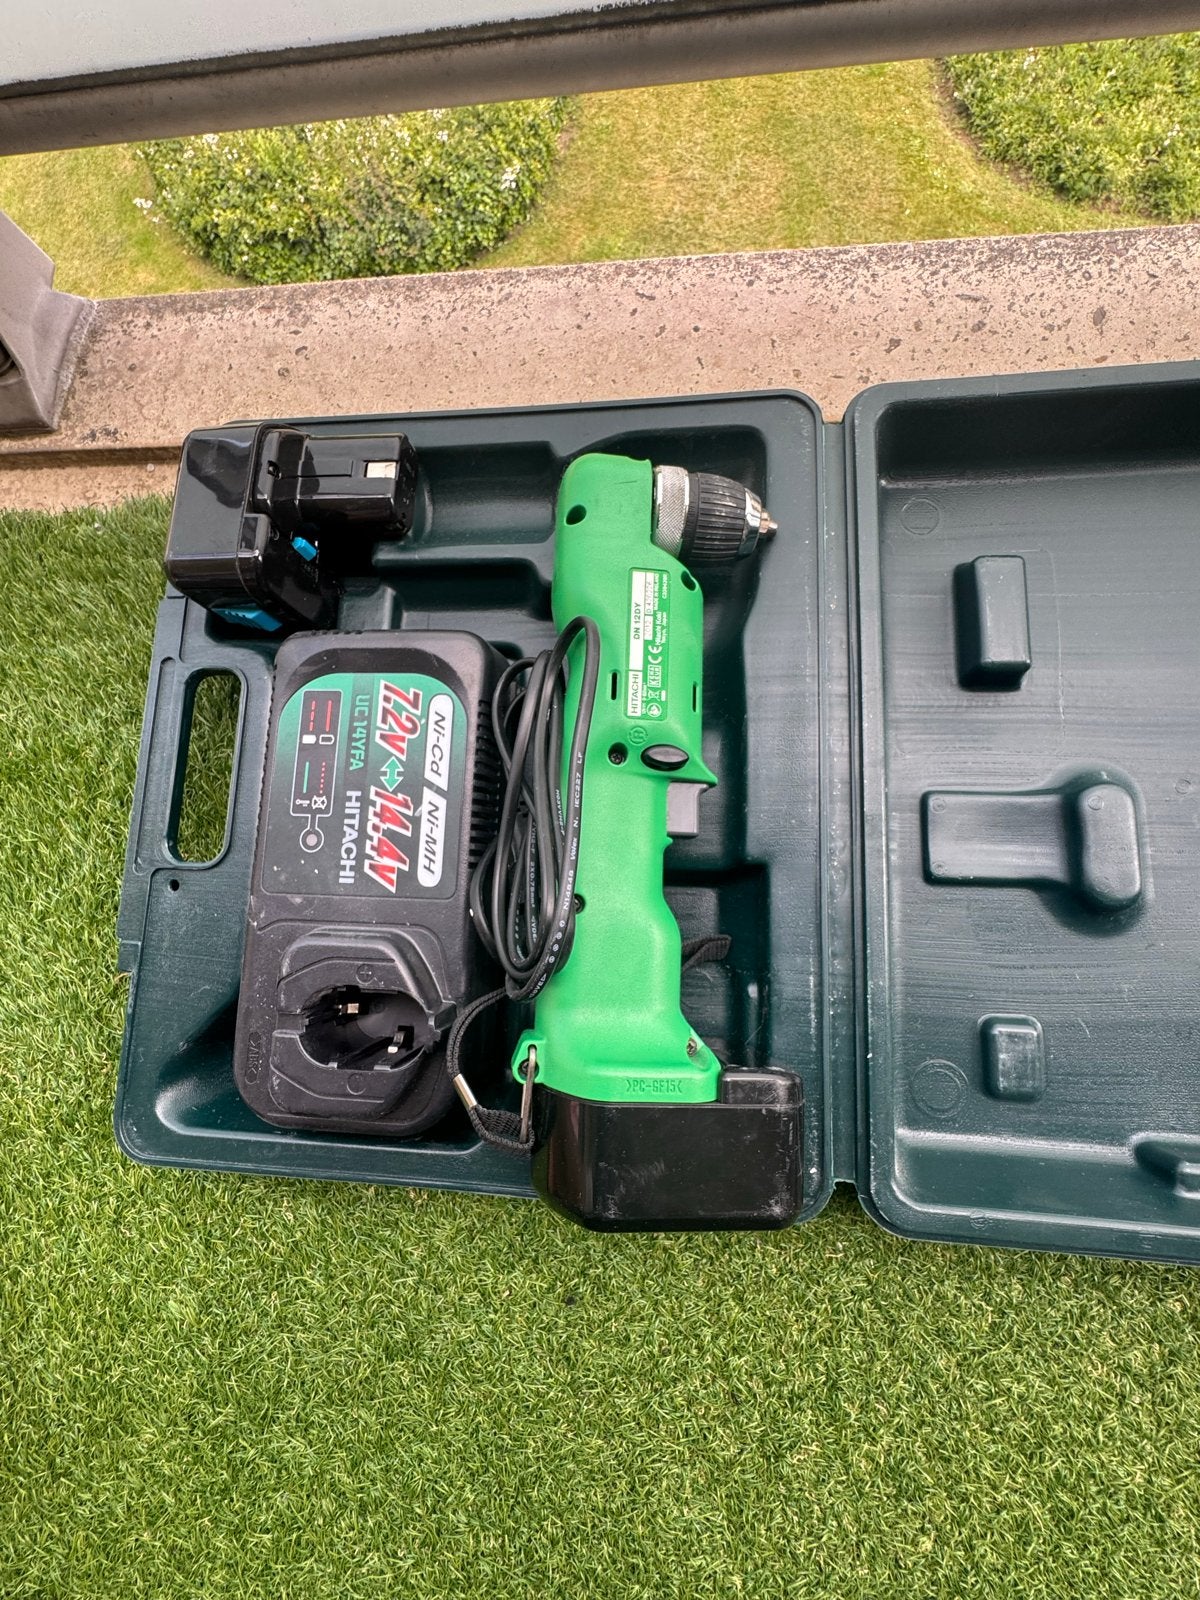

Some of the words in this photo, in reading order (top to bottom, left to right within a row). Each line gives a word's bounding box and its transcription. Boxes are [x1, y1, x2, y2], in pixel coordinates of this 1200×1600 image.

[633, 627, 641, 640] DN
[354, 694, 370, 717] UC
[631, 673, 640, 714] HITACHI
[349, 720, 367, 771] 14YFA
[429, 710, 447, 778] Ni-Cd
[573, 772, 582, 808] IEC227
[338, 789, 362, 885] HITACHI
[423, 800, 440, 875] Ni-MH
